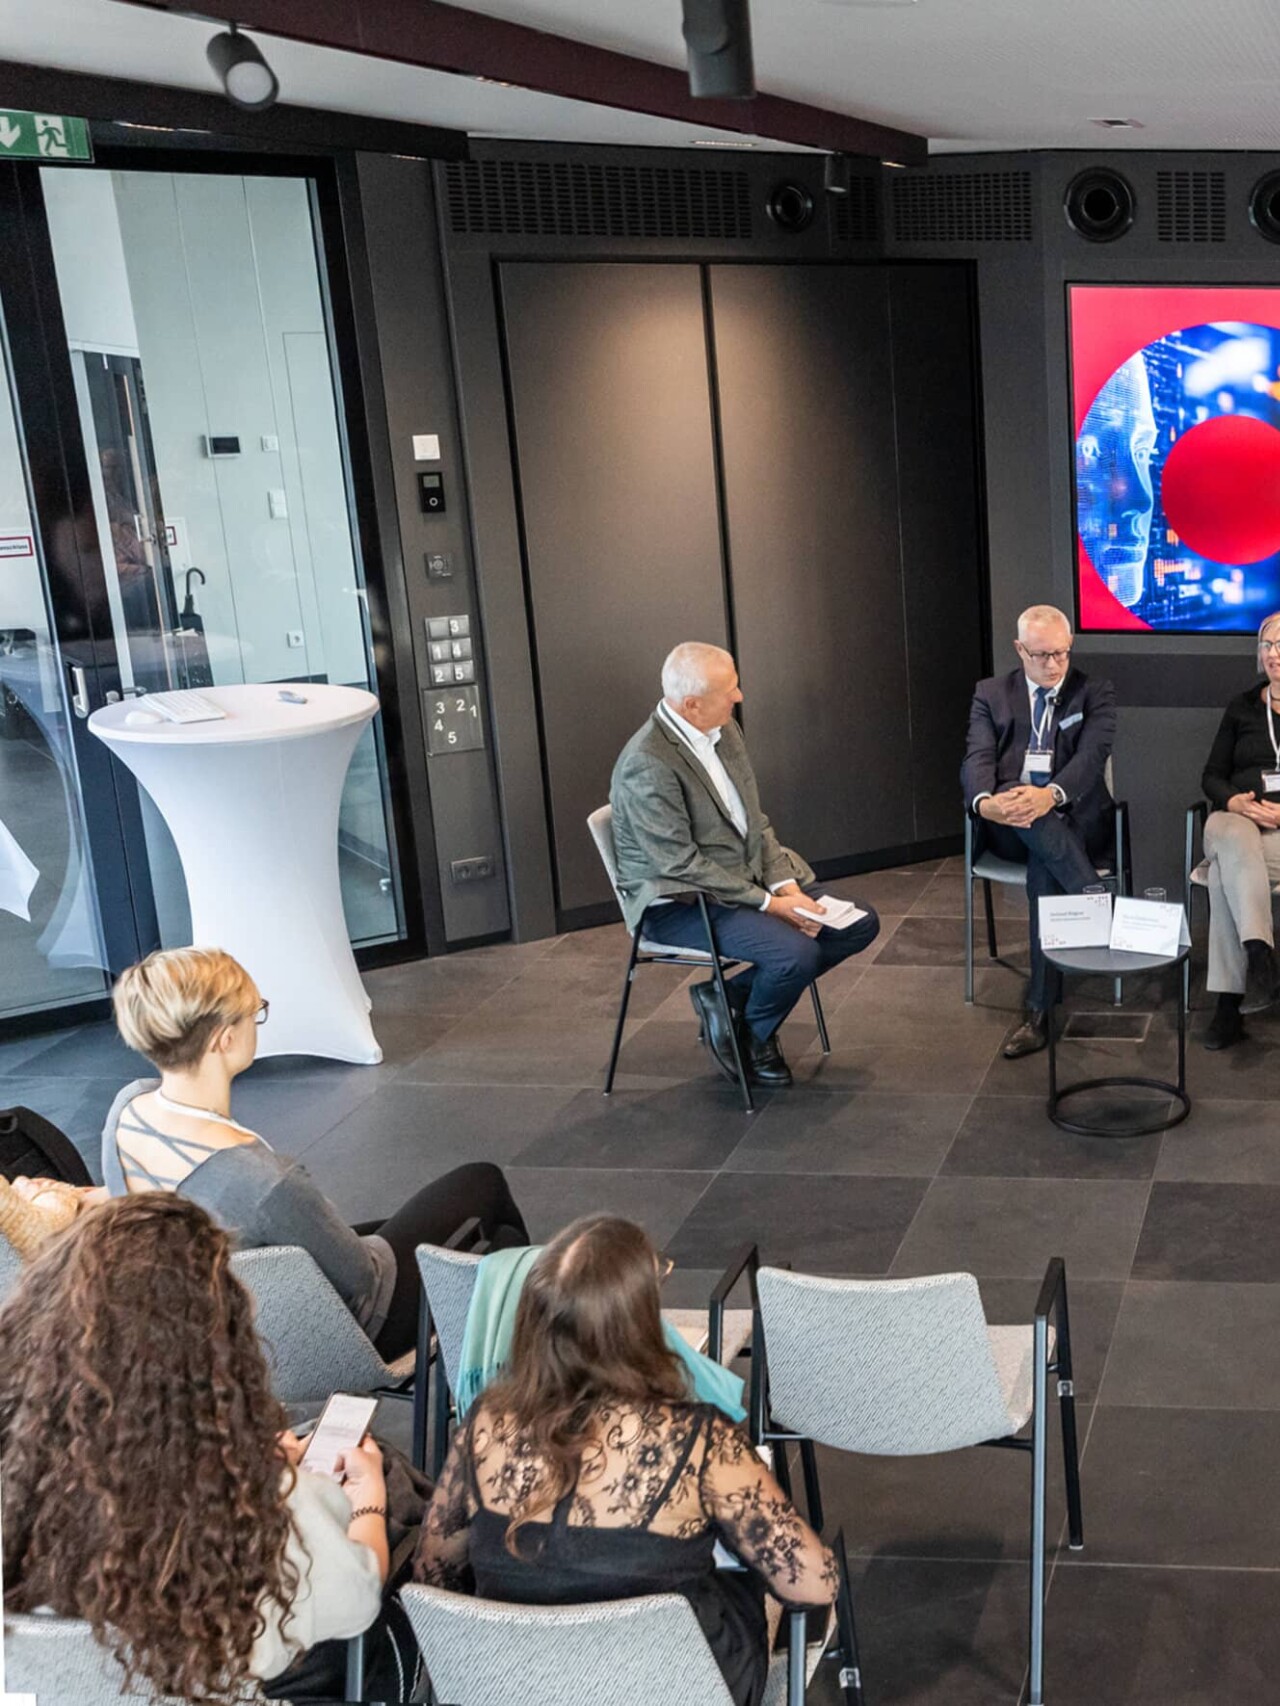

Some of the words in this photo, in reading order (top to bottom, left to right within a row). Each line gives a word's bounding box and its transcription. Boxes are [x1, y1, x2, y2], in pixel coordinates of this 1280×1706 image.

[450, 619, 459, 632] 3
[433, 644, 442, 659] 1
[452, 642, 462, 657] 4
[434, 670, 444, 682] 2
[455, 667, 464, 681] 5
[436, 701, 446, 714] 3
[456, 699, 466, 712] 2
[470, 705, 477, 717] 1
[434, 718, 444, 731] 4
[447, 731, 457, 744] 5
